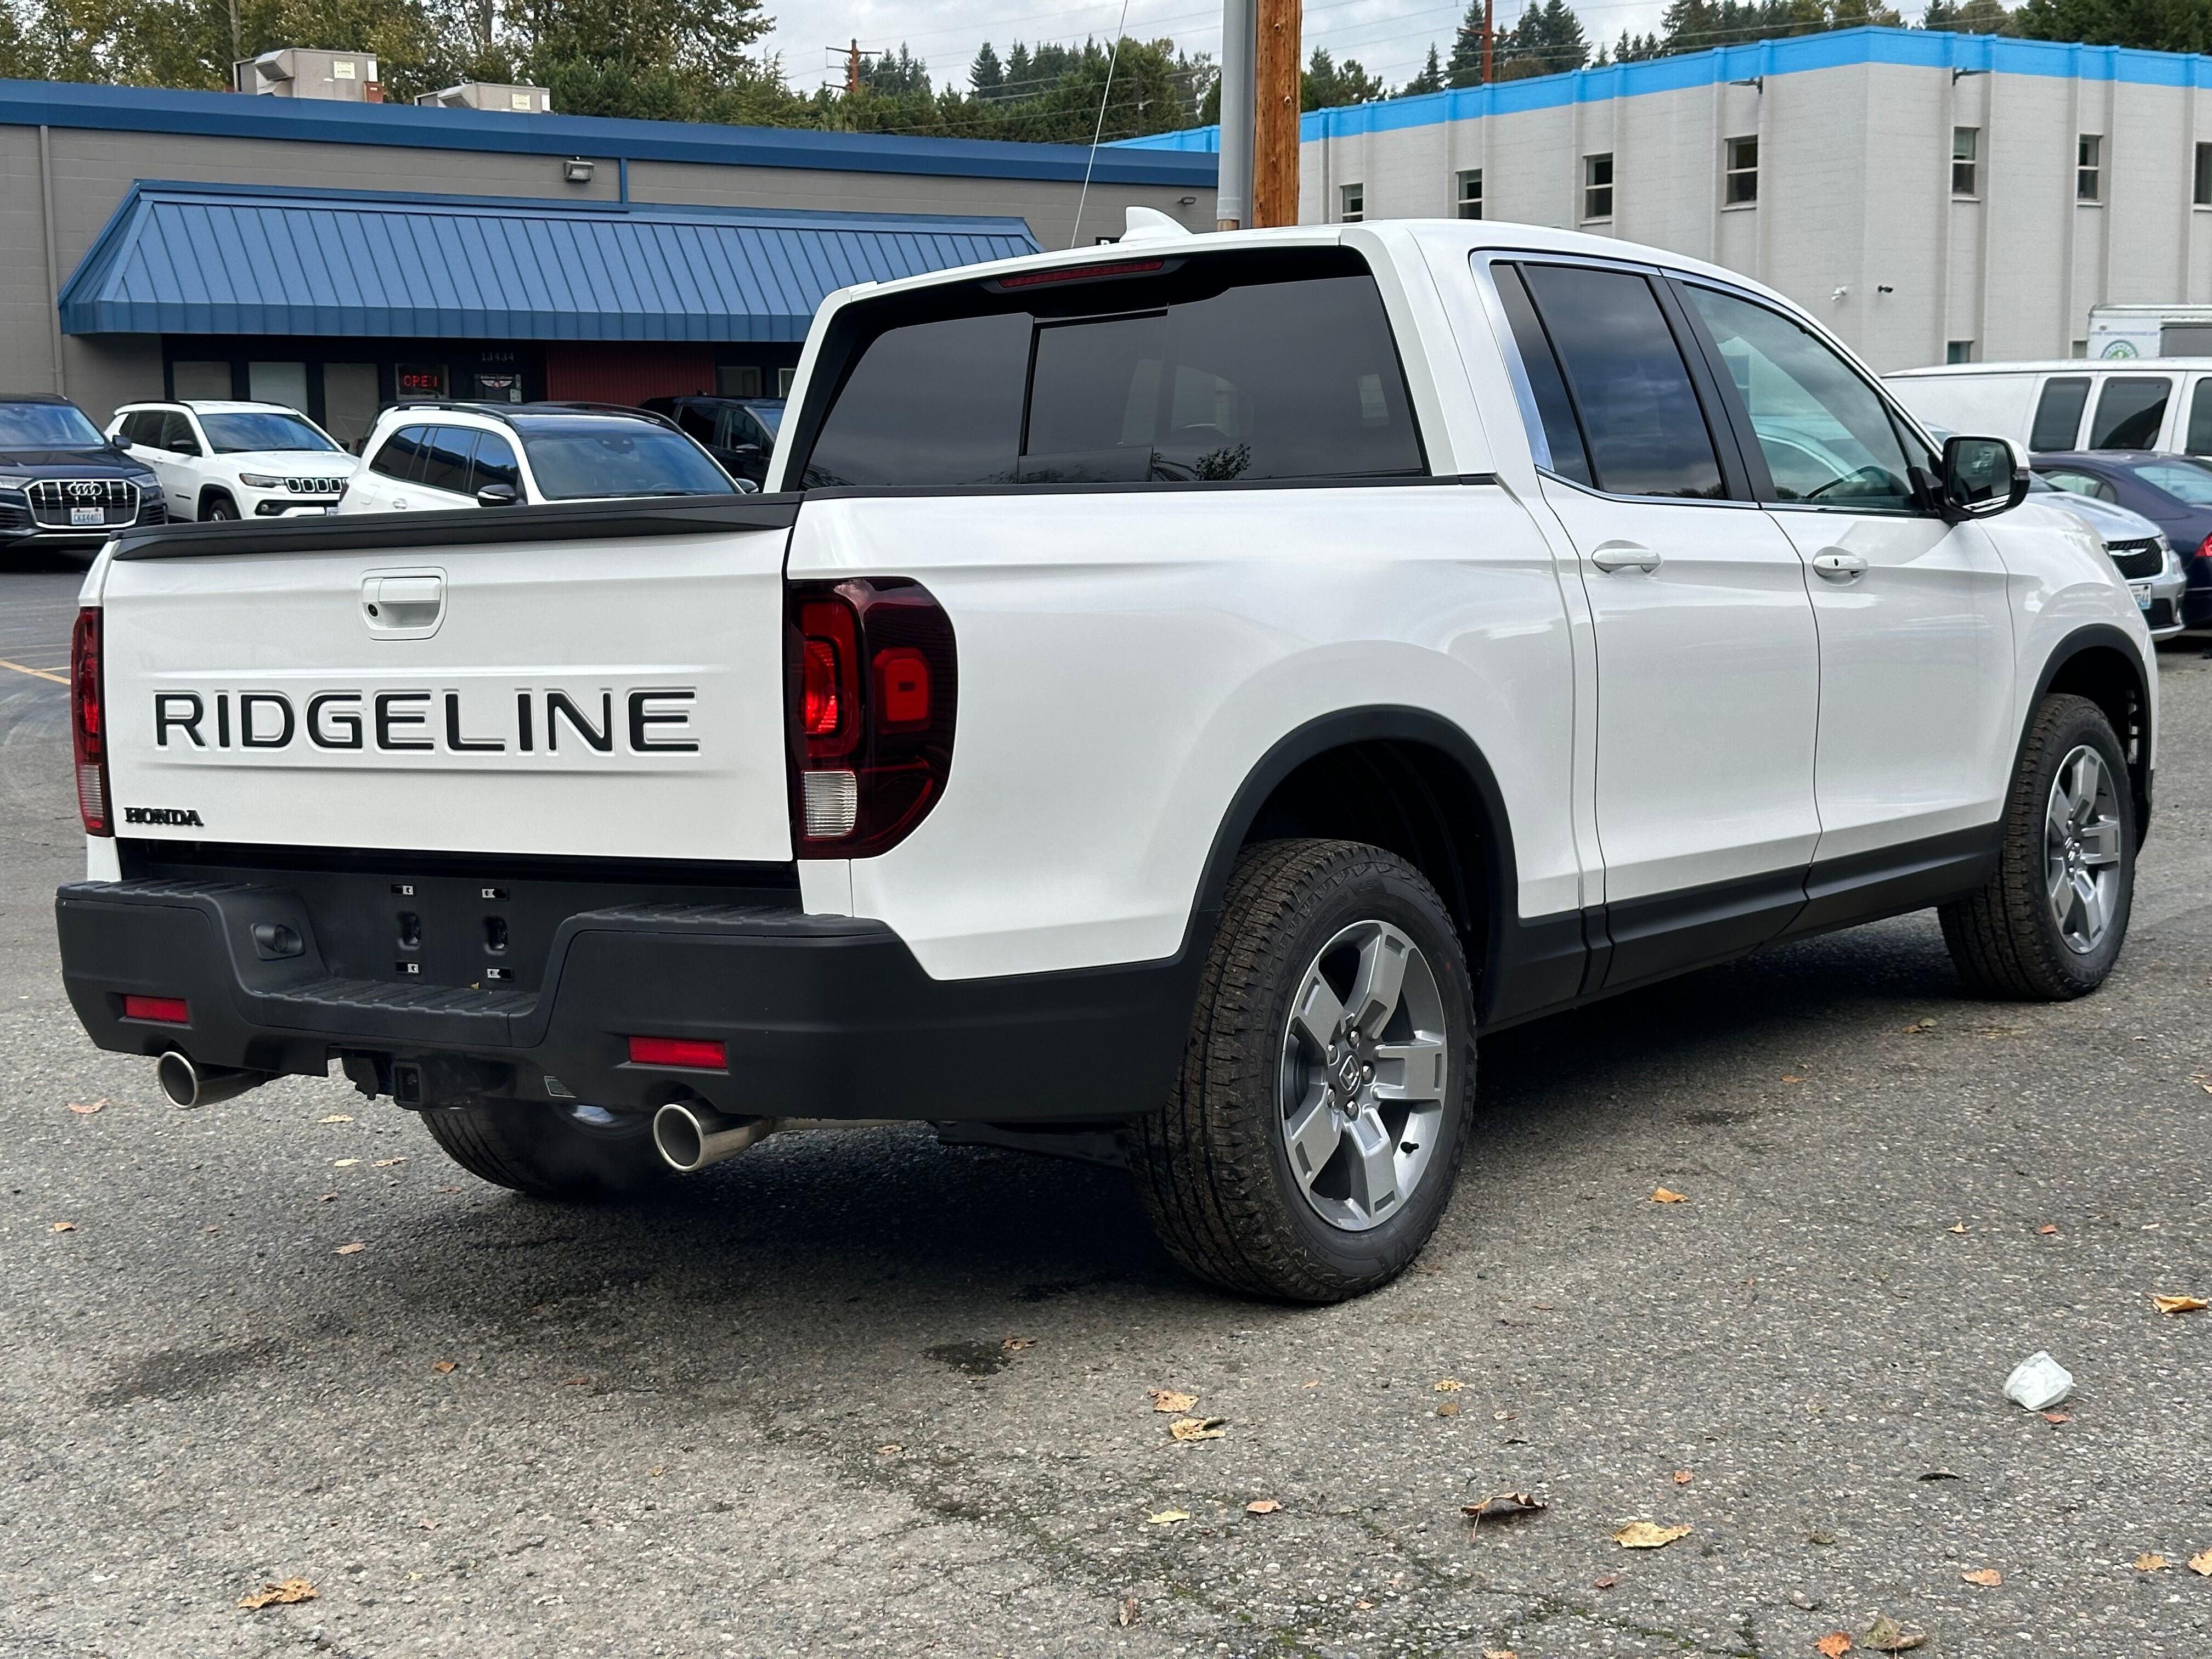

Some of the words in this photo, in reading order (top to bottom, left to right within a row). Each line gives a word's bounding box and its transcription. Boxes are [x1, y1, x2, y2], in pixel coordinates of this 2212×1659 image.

[482, 351, 514, 362] 13434
[154, 690, 700, 754] RIDGELINE
[123, 807, 205, 827] HONDA
